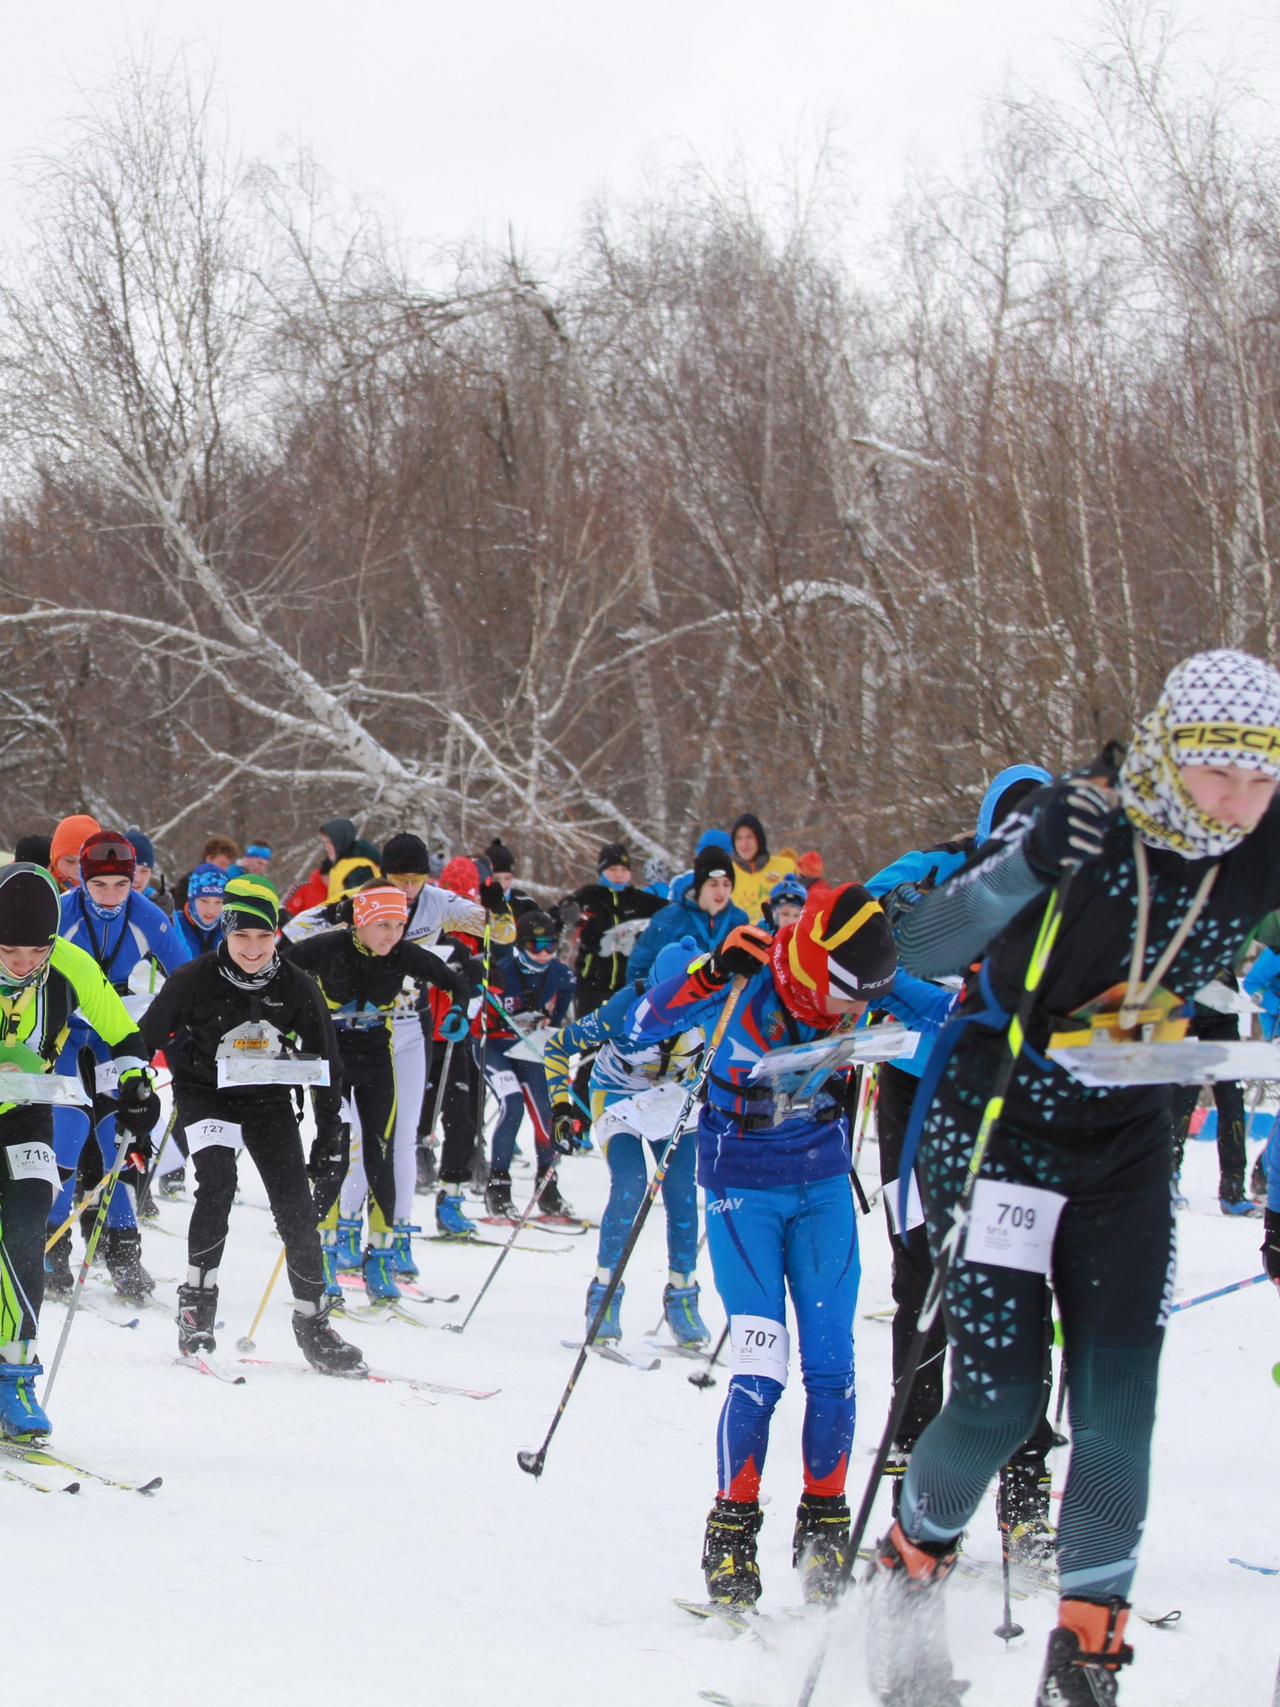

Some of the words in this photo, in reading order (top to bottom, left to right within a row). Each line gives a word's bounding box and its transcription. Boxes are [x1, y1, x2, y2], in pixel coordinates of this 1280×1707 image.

[104, 1067, 118, 1077] 74
[201, 1124, 224, 1134] 727
[23, 1149, 50, 1163] 718
[707, 1198, 744, 1216] RAY
[997, 1203, 1036, 1230] 709
[744, 1329, 778, 1349] 707
